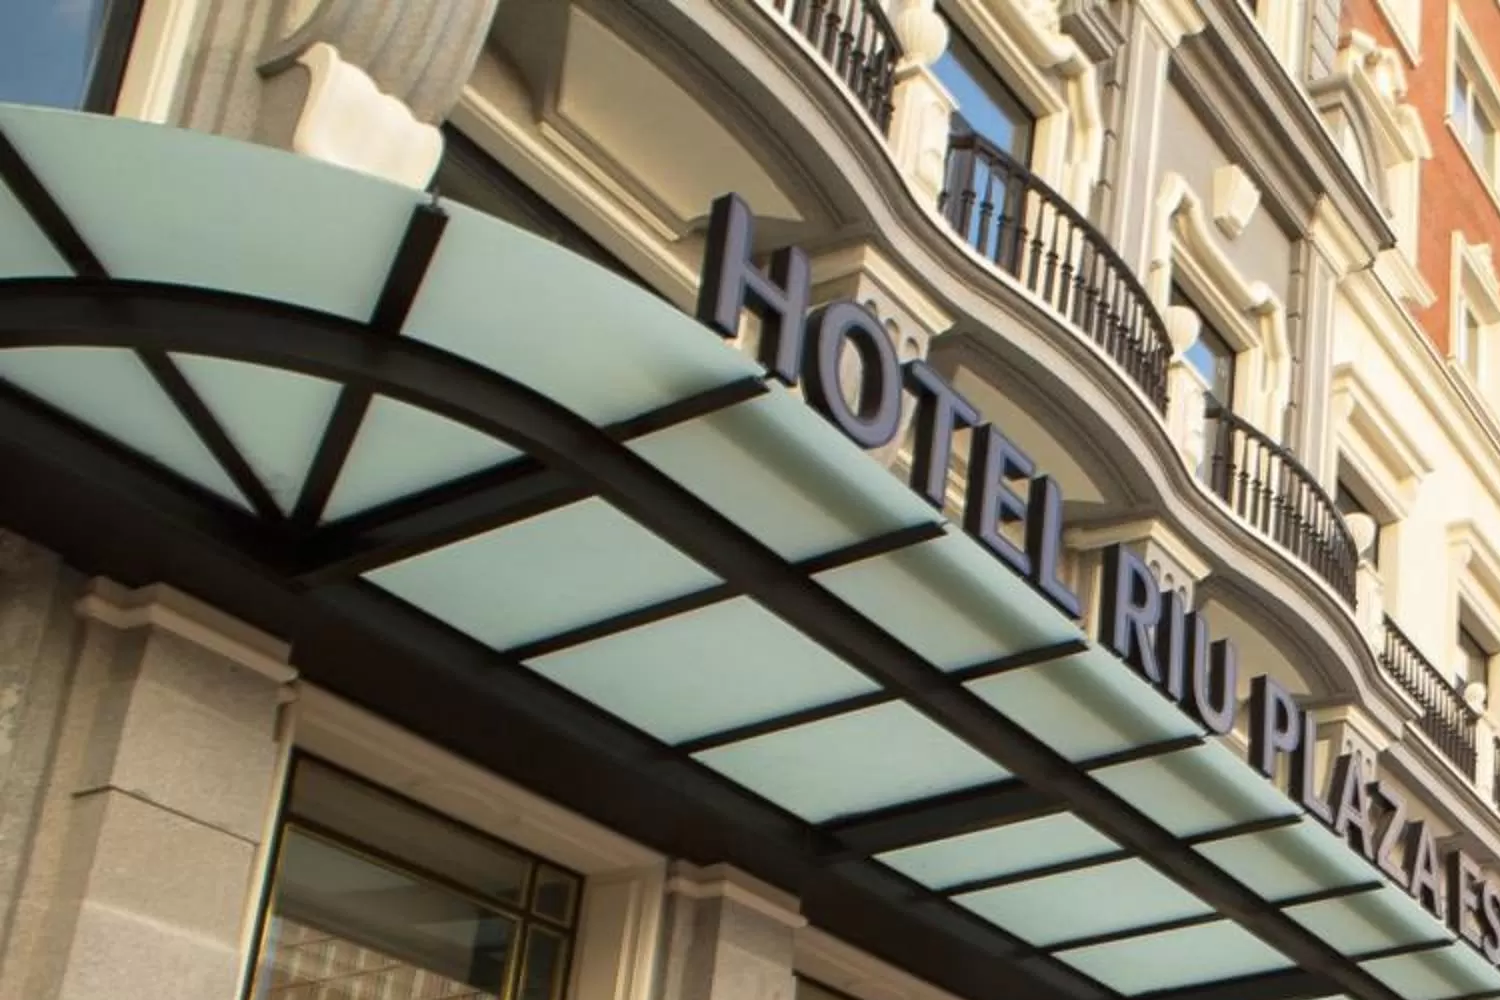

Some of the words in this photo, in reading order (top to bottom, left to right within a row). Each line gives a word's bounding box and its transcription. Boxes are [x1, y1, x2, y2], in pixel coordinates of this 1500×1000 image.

[697, 192, 1081, 620] HOTEL
[1097, 542, 1237, 736] RIU
[1248, 674, 1446, 921] PLAZA
